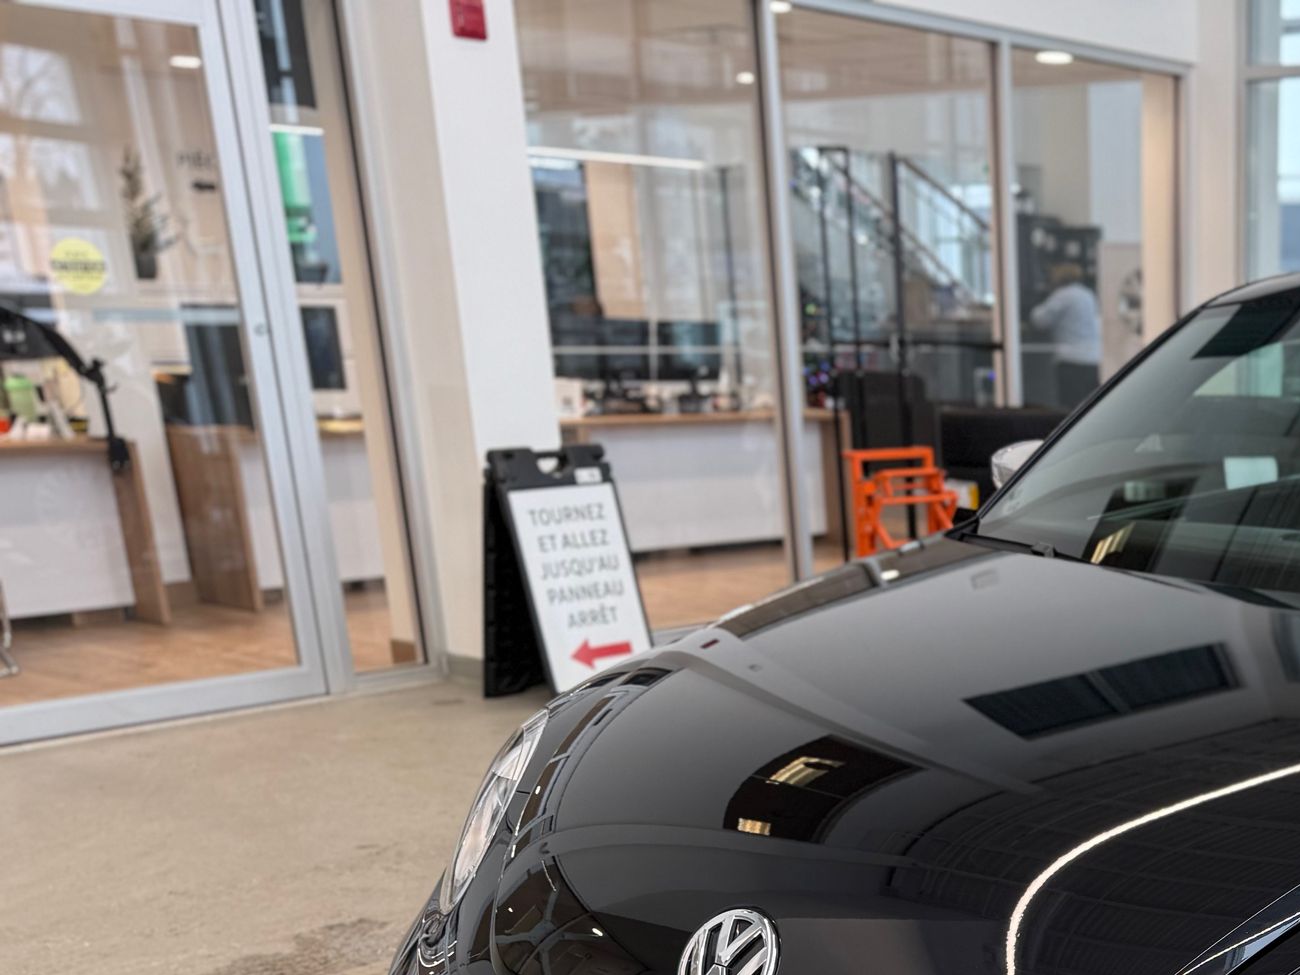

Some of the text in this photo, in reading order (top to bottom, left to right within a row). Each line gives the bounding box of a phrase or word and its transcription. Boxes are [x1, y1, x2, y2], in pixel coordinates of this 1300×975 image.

[528, 503, 605, 527] TOURNEZ
[538, 529, 609, 551] ET ALLEZ
[541, 556, 619, 580] JUSQU'AU
[546, 580, 624, 605] PANNEAU
[568, 605, 616, 628] ARRÊT
